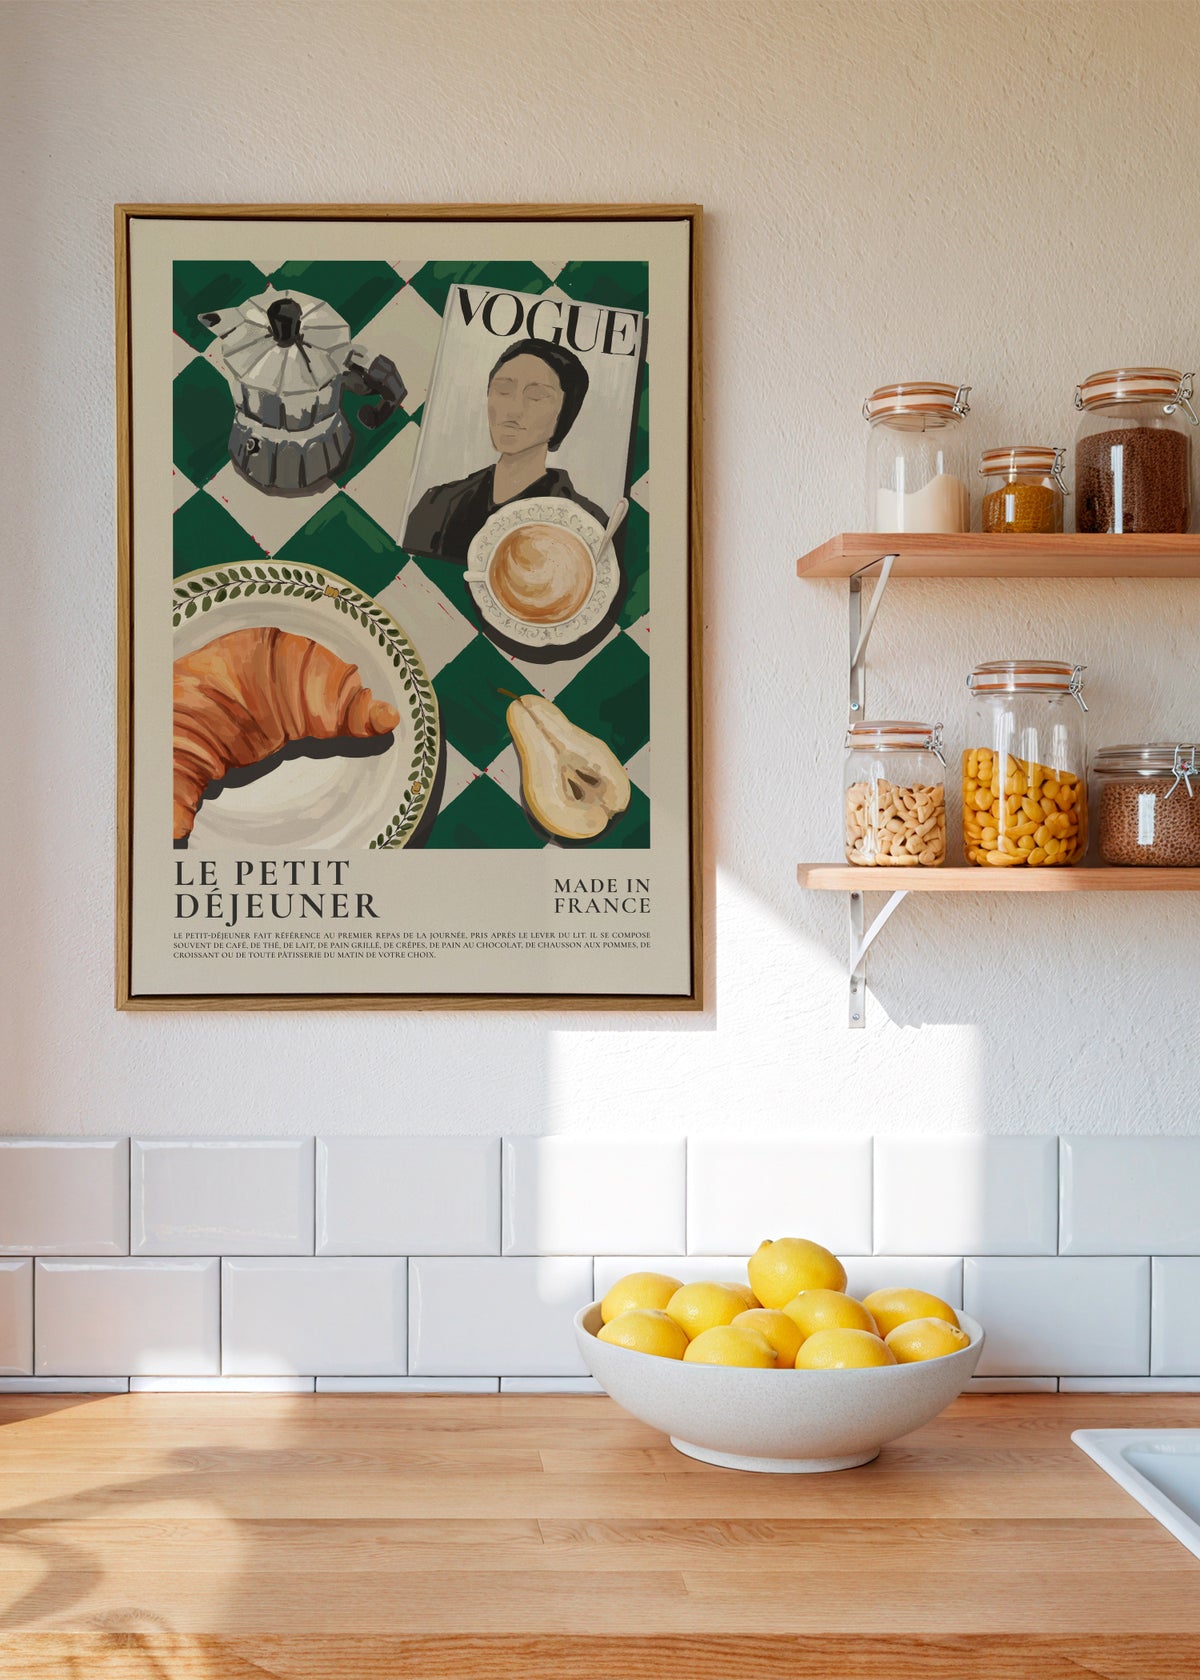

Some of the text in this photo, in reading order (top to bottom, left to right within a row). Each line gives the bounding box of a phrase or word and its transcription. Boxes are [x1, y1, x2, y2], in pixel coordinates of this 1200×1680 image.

[457, 287, 640, 356] VOGUE
[174, 860, 350, 886] LE PETIT
[554, 878, 650, 893] MADE IN
[174, 888, 381, 927] DÉJEUNER
[554, 897, 651, 914] FRANCE
[173, 931, 183, 939] LE
[185, 931, 250, 939] PETIT-DÉJEUNER
[253, 931, 272, 939] FAIT
[275, 931, 320, 939] RÉFÉRENCE
[324, 931, 335, 939] AU
[338, 931, 372, 939] PREMIER
[376, 931, 400, 939] REPAS
[403, 931, 413, 939] DE
[416, 931, 427, 939] LA
[471, 931, 488, 939] PRIS
[518, 931, 528, 939] LE
[530, 931, 555, 939] LEVER
[558, 931, 570, 939] DU
[590, 931, 597, 939] IL
[601, 931, 609, 939] SE
[611, 931, 651, 939] COMPOSE
[173, 941, 211, 949] SOUVENT
[213, 941, 223, 949] DE
[226, 941, 248, 949] CAFÉ,
[250, 941, 260, 949] DE
[283, 941, 293, 949] DE
[317, 941, 328, 949] DE
[330, 941, 349, 949] PAIN
[351, 941, 381, 949] GRILLÉ,
[384, 941, 394, 949] DE
[429, 941, 439, 949] DE
[441, 941, 460, 949] PAIN
[463, 941, 474, 949] AU
[525, 941, 535, 949] DE
[538, 941, 581, 949] CHAUSSON
[584, 941, 600, 949] AUX
[640, 941, 651, 949] DE
[173, 951, 219, 959] CROISSANT
[221, 951, 233, 959] OU
[236, 951, 246, 959] DE
[248, 951, 275, 959] TOUTE
[324, 951, 335, 959] DU
[337, 951, 363, 959] MATIN
[366, 951, 376, 959] DE
[378, 951, 405, 959] VOTRE
